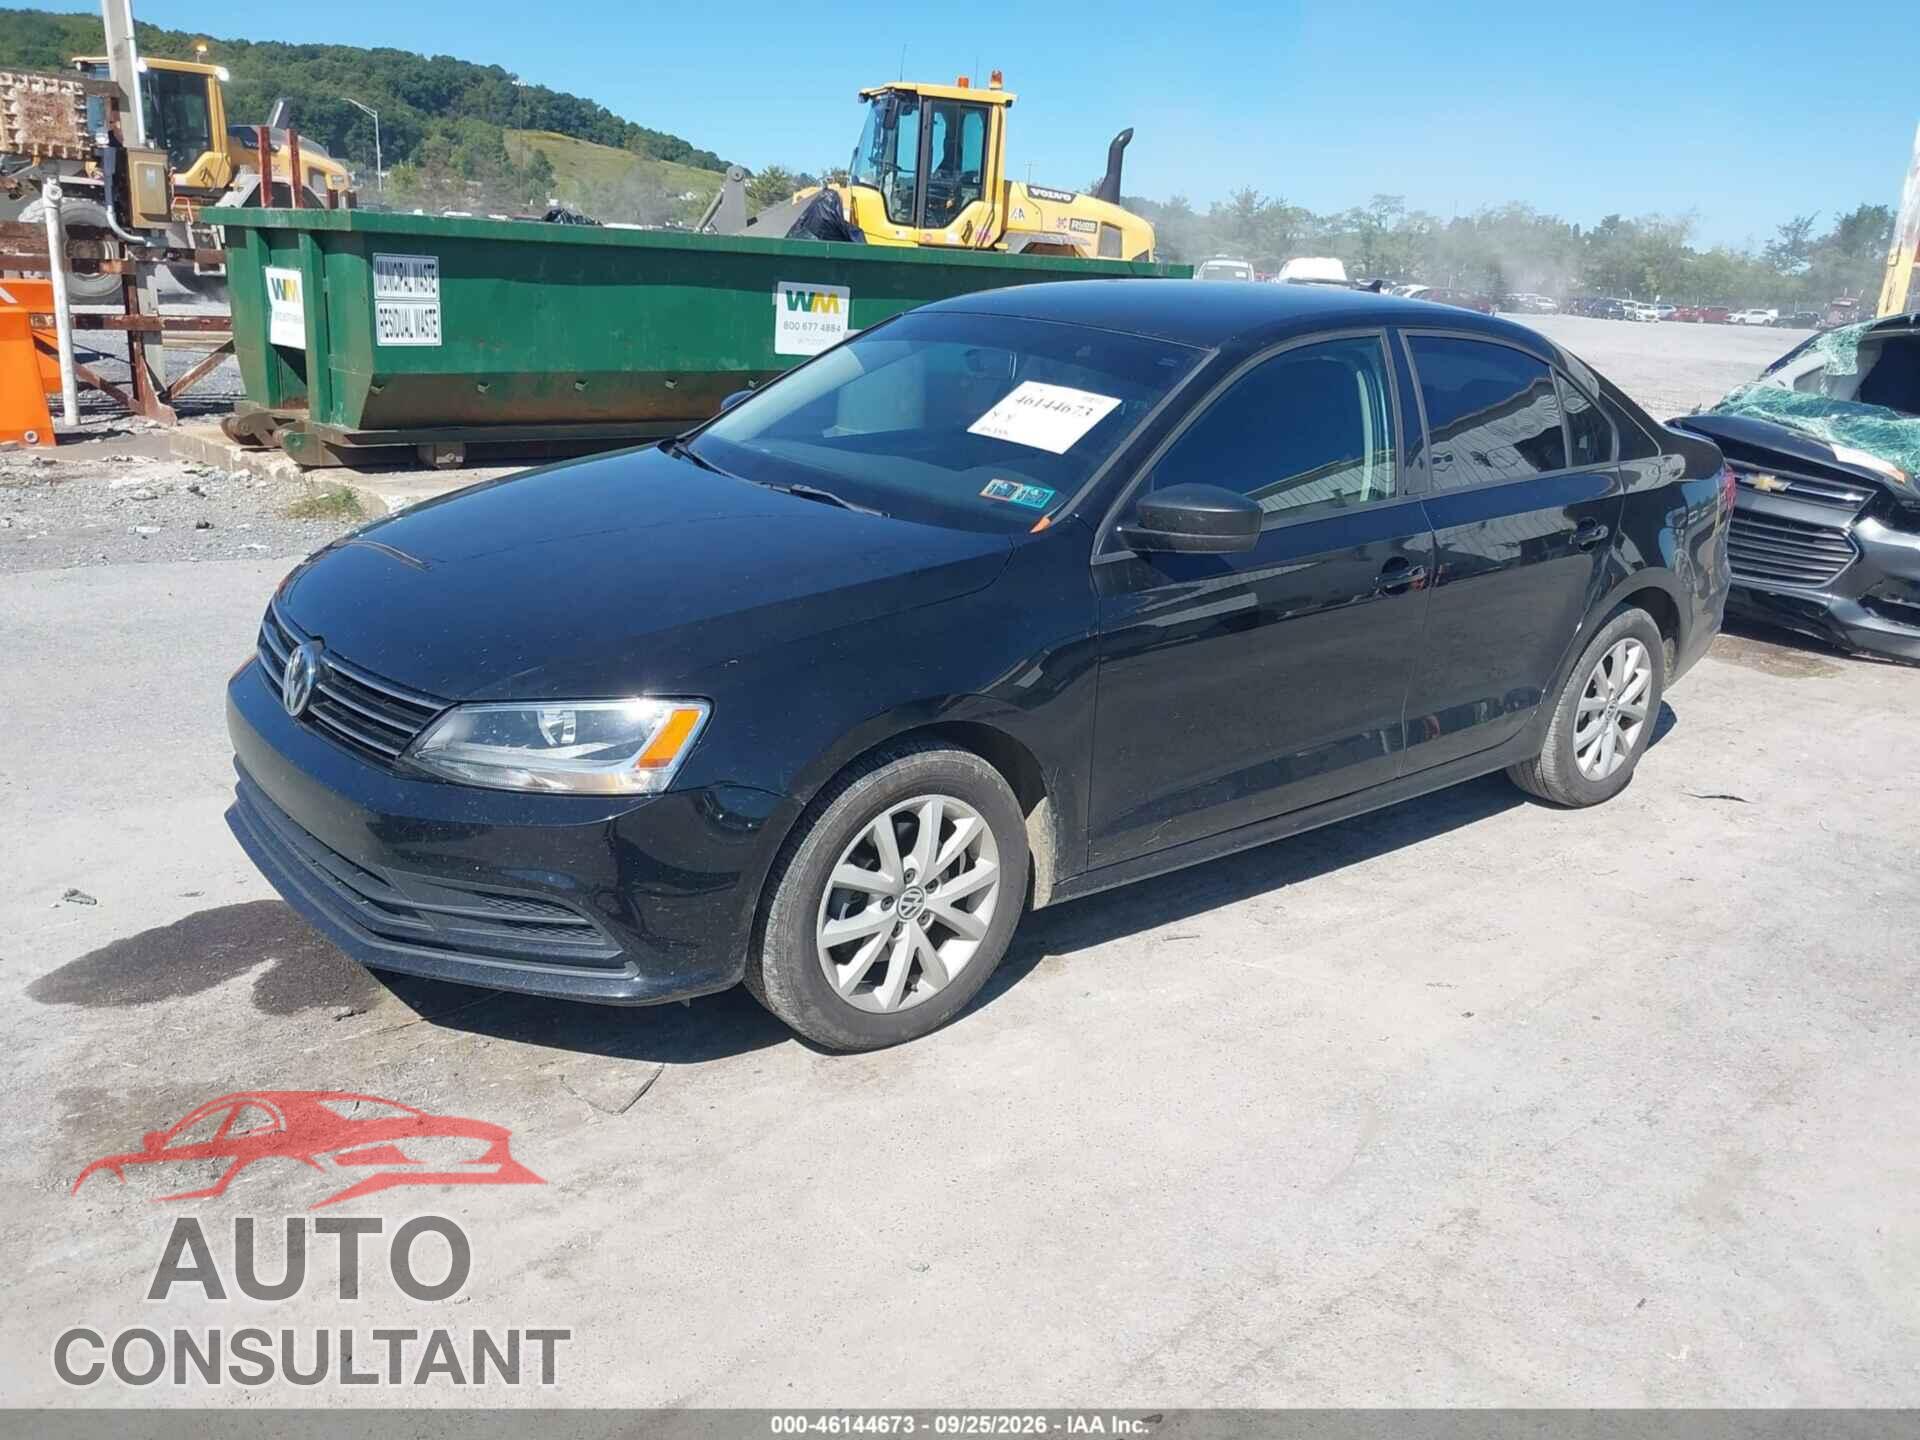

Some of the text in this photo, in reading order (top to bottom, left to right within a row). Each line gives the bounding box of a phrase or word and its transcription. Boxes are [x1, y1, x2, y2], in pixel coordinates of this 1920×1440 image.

[1031, 188, 1072, 202] VOLVO
[270, 277, 301, 303] WM
[414, 263, 436, 294] WASTE
[785, 289, 840, 314] WM
[379, 308, 437, 338] RESIDUAL WASTE
[1016, 394, 1094, 417] 46144673
